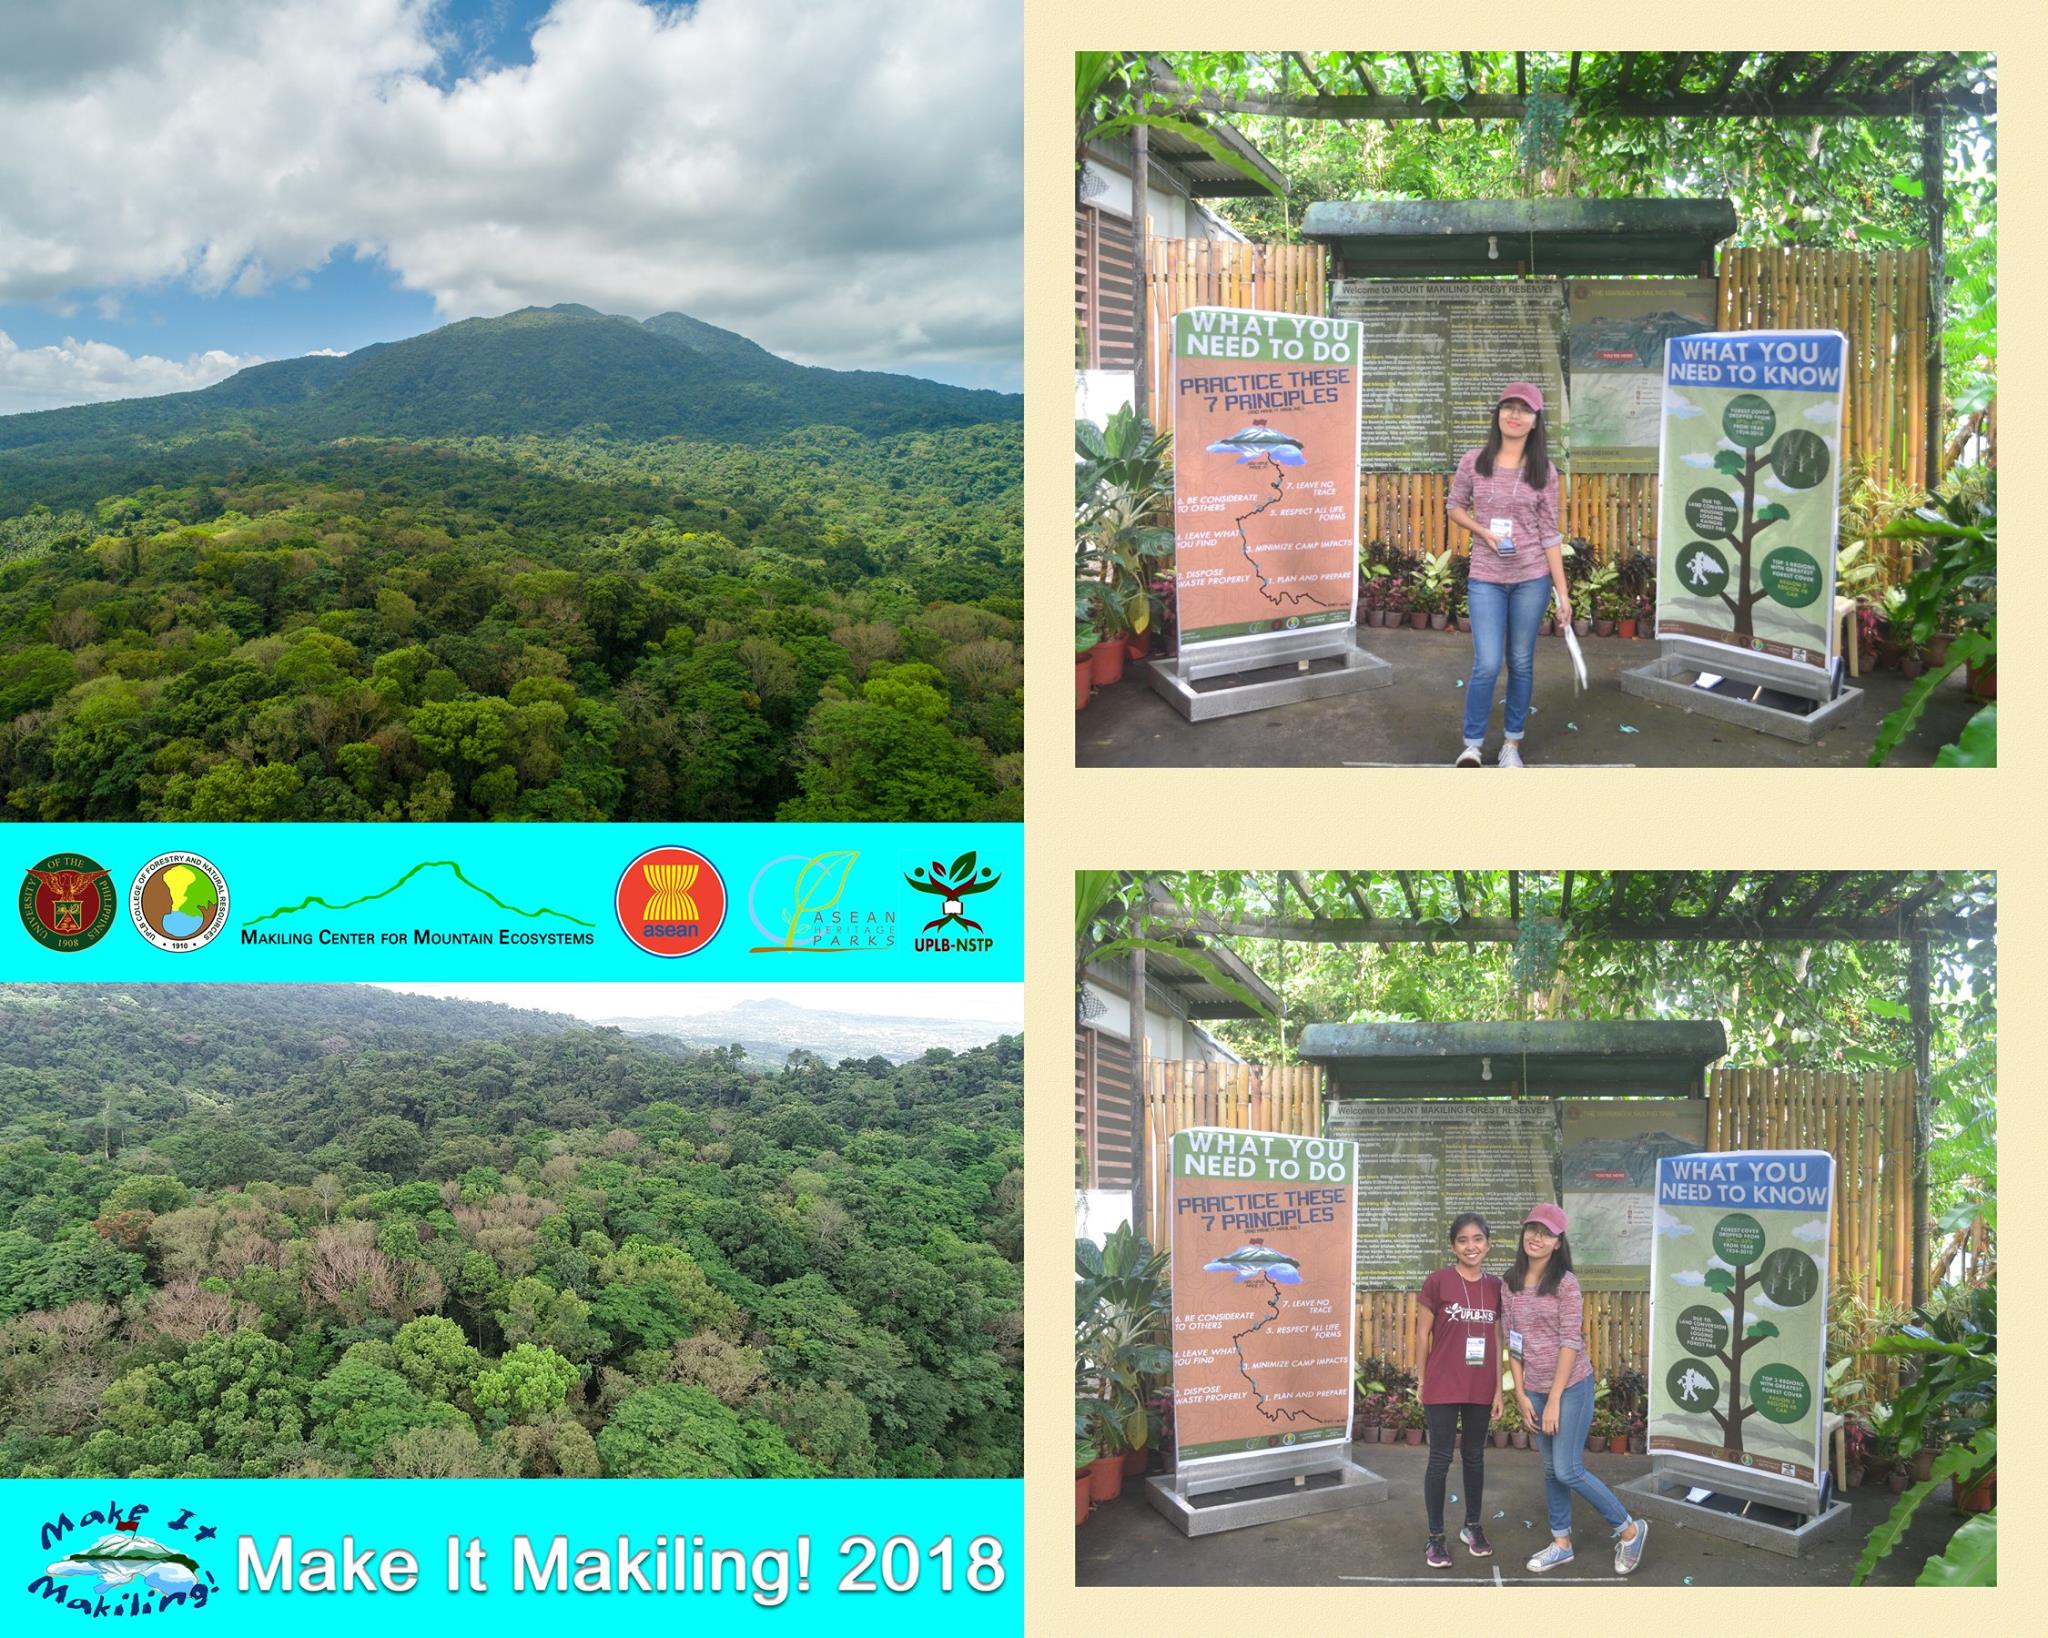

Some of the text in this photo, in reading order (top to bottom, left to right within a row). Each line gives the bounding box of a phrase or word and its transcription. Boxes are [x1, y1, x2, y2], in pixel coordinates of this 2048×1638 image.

[1342, 285, 1552, 294] Welcome to MOUNT MAKILING FOREST RESERVE!
[1190, 312, 1349, 341] WHAT YOU
[1187, 334, 1350, 362] NEED TO DO
[1681, 341, 1818, 363] WHAT YOU
[1671, 363, 1839, 386] NEED TO KNOW
[1180, 369, 1350, 395] PRACTICE THESE
[1204, 397, 1217, 412] 7
[1225, 387, 1338, 411] PRINCIPLES
[1187, 495, 1258, 505] BE CONSIDERATE
[1177, 504, 1226, 513] TO OTHERS
[1280, 507, 1313, 516] RESPECT
[1315, 506, 1327, 514] ALL
[1329, 505, 1344, 513] LIFE
[1318, 513, 1346, 521] FORMS
[1185, 529, 1240, 540] LEAVE WHAT
[1177, 539, 1217, 549] YOU FIND
[1255, 539, 1352, 552] MINIMIZE CAMP IMPACTS
[1186, 569, 1224, 578] DISPOSE
[1277, 571, 1352, 584] PLAN AND PREPARE
[1177, 575, 1251, 588] WASTE PROPERLY
[1338, 1107, 1374, 1115] Welcome
[1387, 1106, 1419, 1114] MOUNT
[1421, 1106, 1464, 1114] MAKILING
[1465, 1106, 1500, 1114] FOREST
[1502, 1106, 1545, 1114] RESERVE!
[1188, 1131, 1344, 1161] WHAT YOU
[1185, 1154, 1346, 1182] NEED TO DO
[1672, 1161, 1807, 1183] WHAT YOU
[1662, 1183, 1827, 1205] NEED TO KNOW
[1178, 1188, 1346, 1215] PRACTICE THESE
[1201, 1207, 1334, 1232] 7 PRINCIPLES
[1309, 1306, 1332, 1314] TRACE
[1185, 1312, 1255, 1323] BE CONSIDERATE
[1175, 1322, 1223, 1331] TO OTHERS
[1276, 1326, 1309, 1335] RESPECT
[1314, 1331, 1342, 1339] FORMS
[1182, 1347, 1237, 1358] LEAVE WHAT
[1174, 1357, 1215, 1367] YOU FIND
[1252, 1361, 1289, 1370] MINIMIZE
[1291, 1359, 1316, 1368] CAMP
[1316, 1357, 1348, 1366] IMPACTS
[1183, 1386, 1221, 1396] DISPOSE
[1274, 1391, 1293, 1400] PLAN
[1295, 1390, 1314, 1399] AND
[1316, 1388, 1347, 1397] PREPARE
[1175, 1392, 1248, 1406] WASTE PROPERLY
